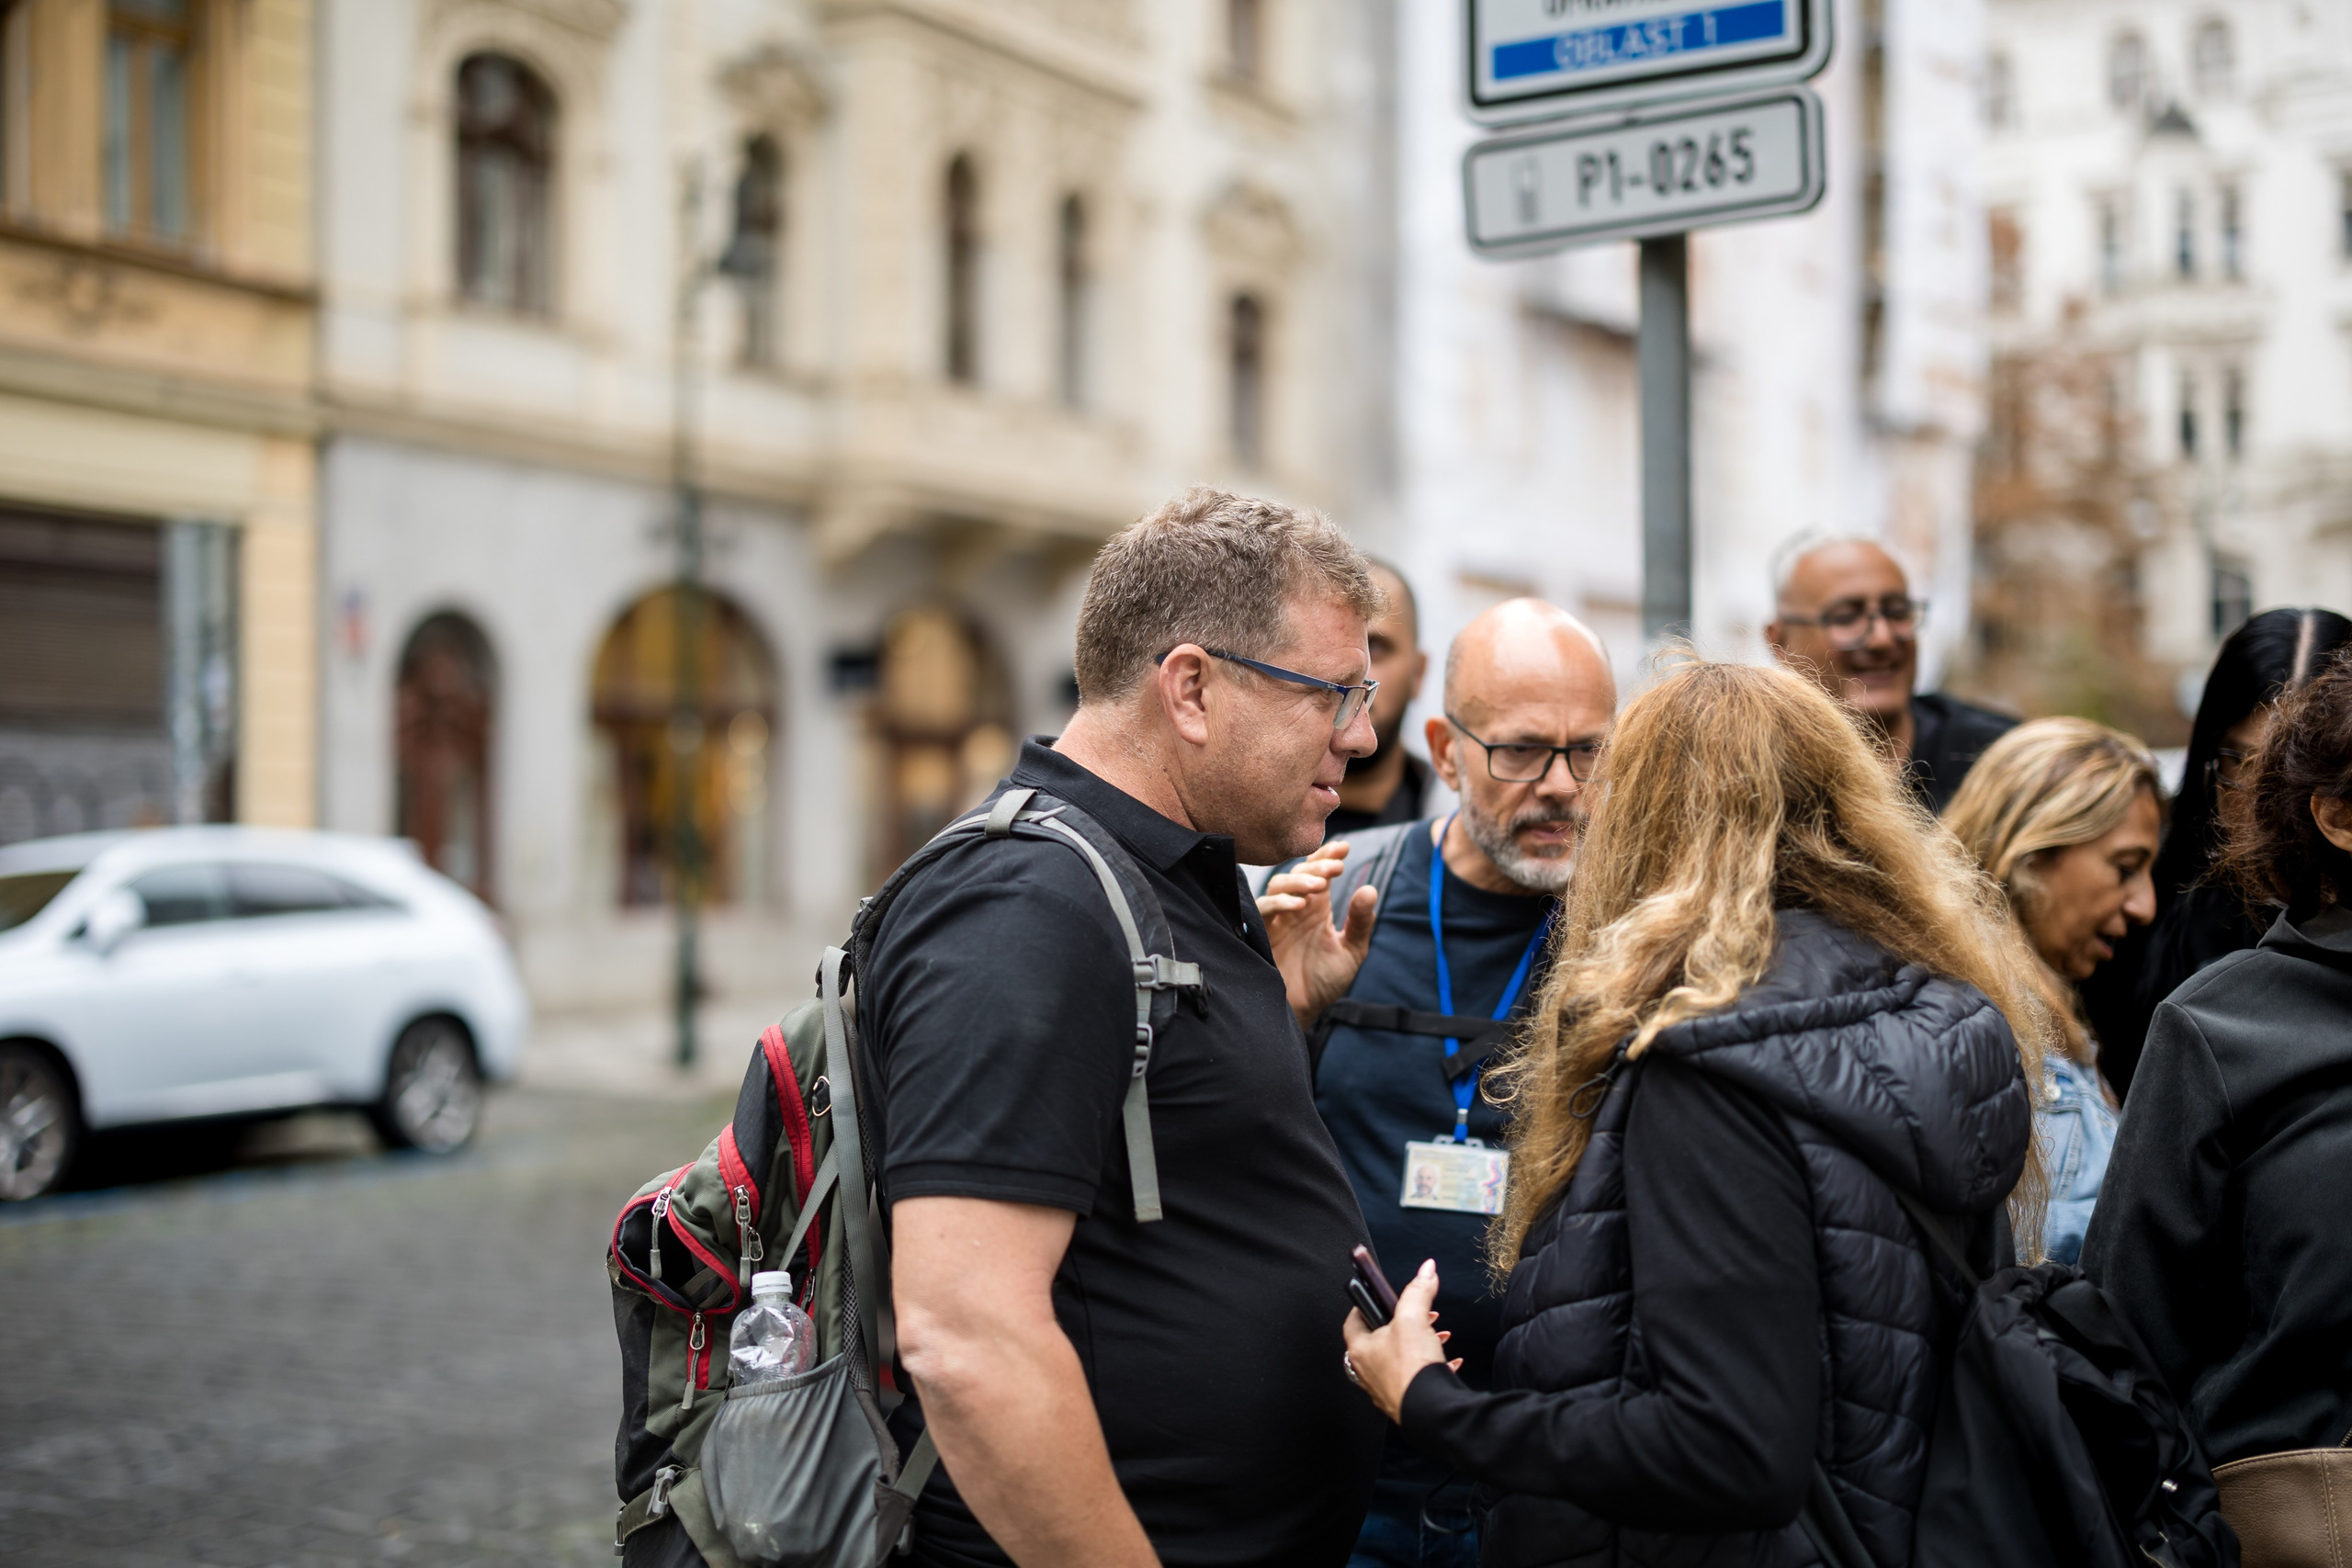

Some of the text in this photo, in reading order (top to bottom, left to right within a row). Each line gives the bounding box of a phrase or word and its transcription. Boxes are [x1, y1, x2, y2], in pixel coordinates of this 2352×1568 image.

[1554, 12, 1716, 70] OBLAST 1
[1577, 128, 1754, 207] P1-0265
